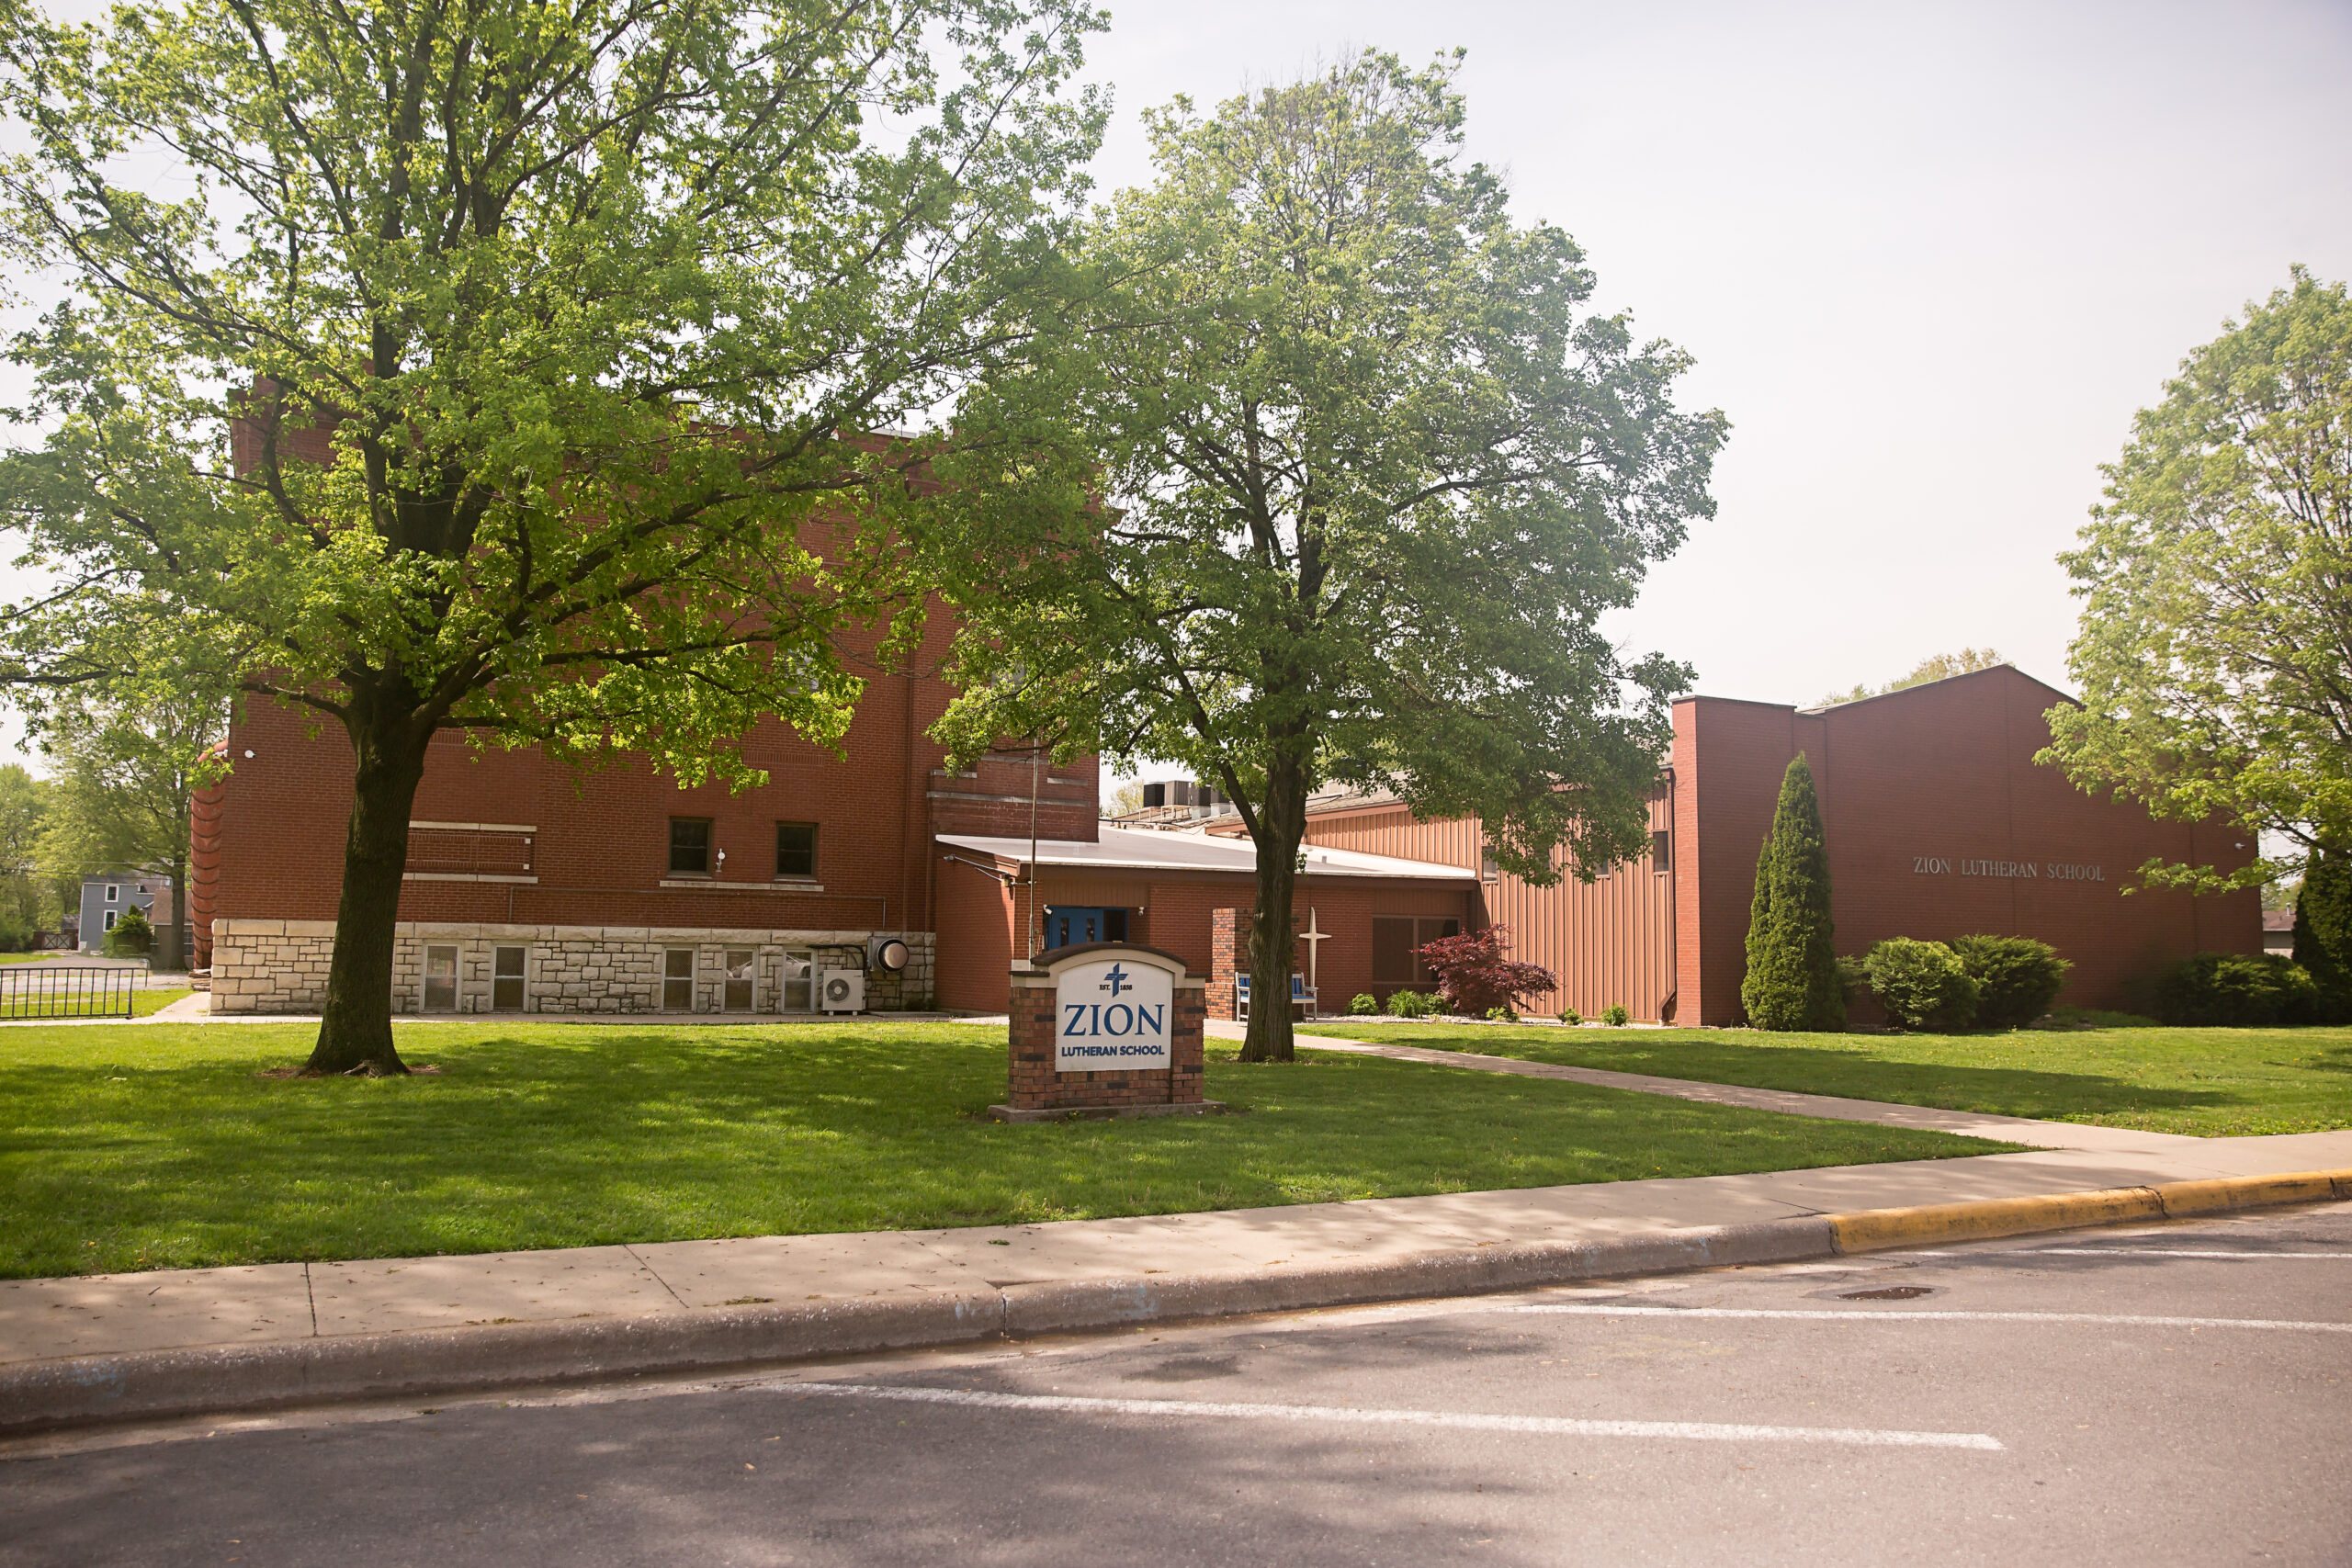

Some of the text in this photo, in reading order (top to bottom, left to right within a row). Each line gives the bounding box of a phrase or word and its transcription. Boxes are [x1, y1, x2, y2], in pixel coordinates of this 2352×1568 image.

[1913, 857, 2106, 882] ZION LUTHERAN SCHOOL
[1063, 1004, 1165, 1036] ZION
[1062, 1045, 1165, 1056] LUTHERAN SCHOOL
